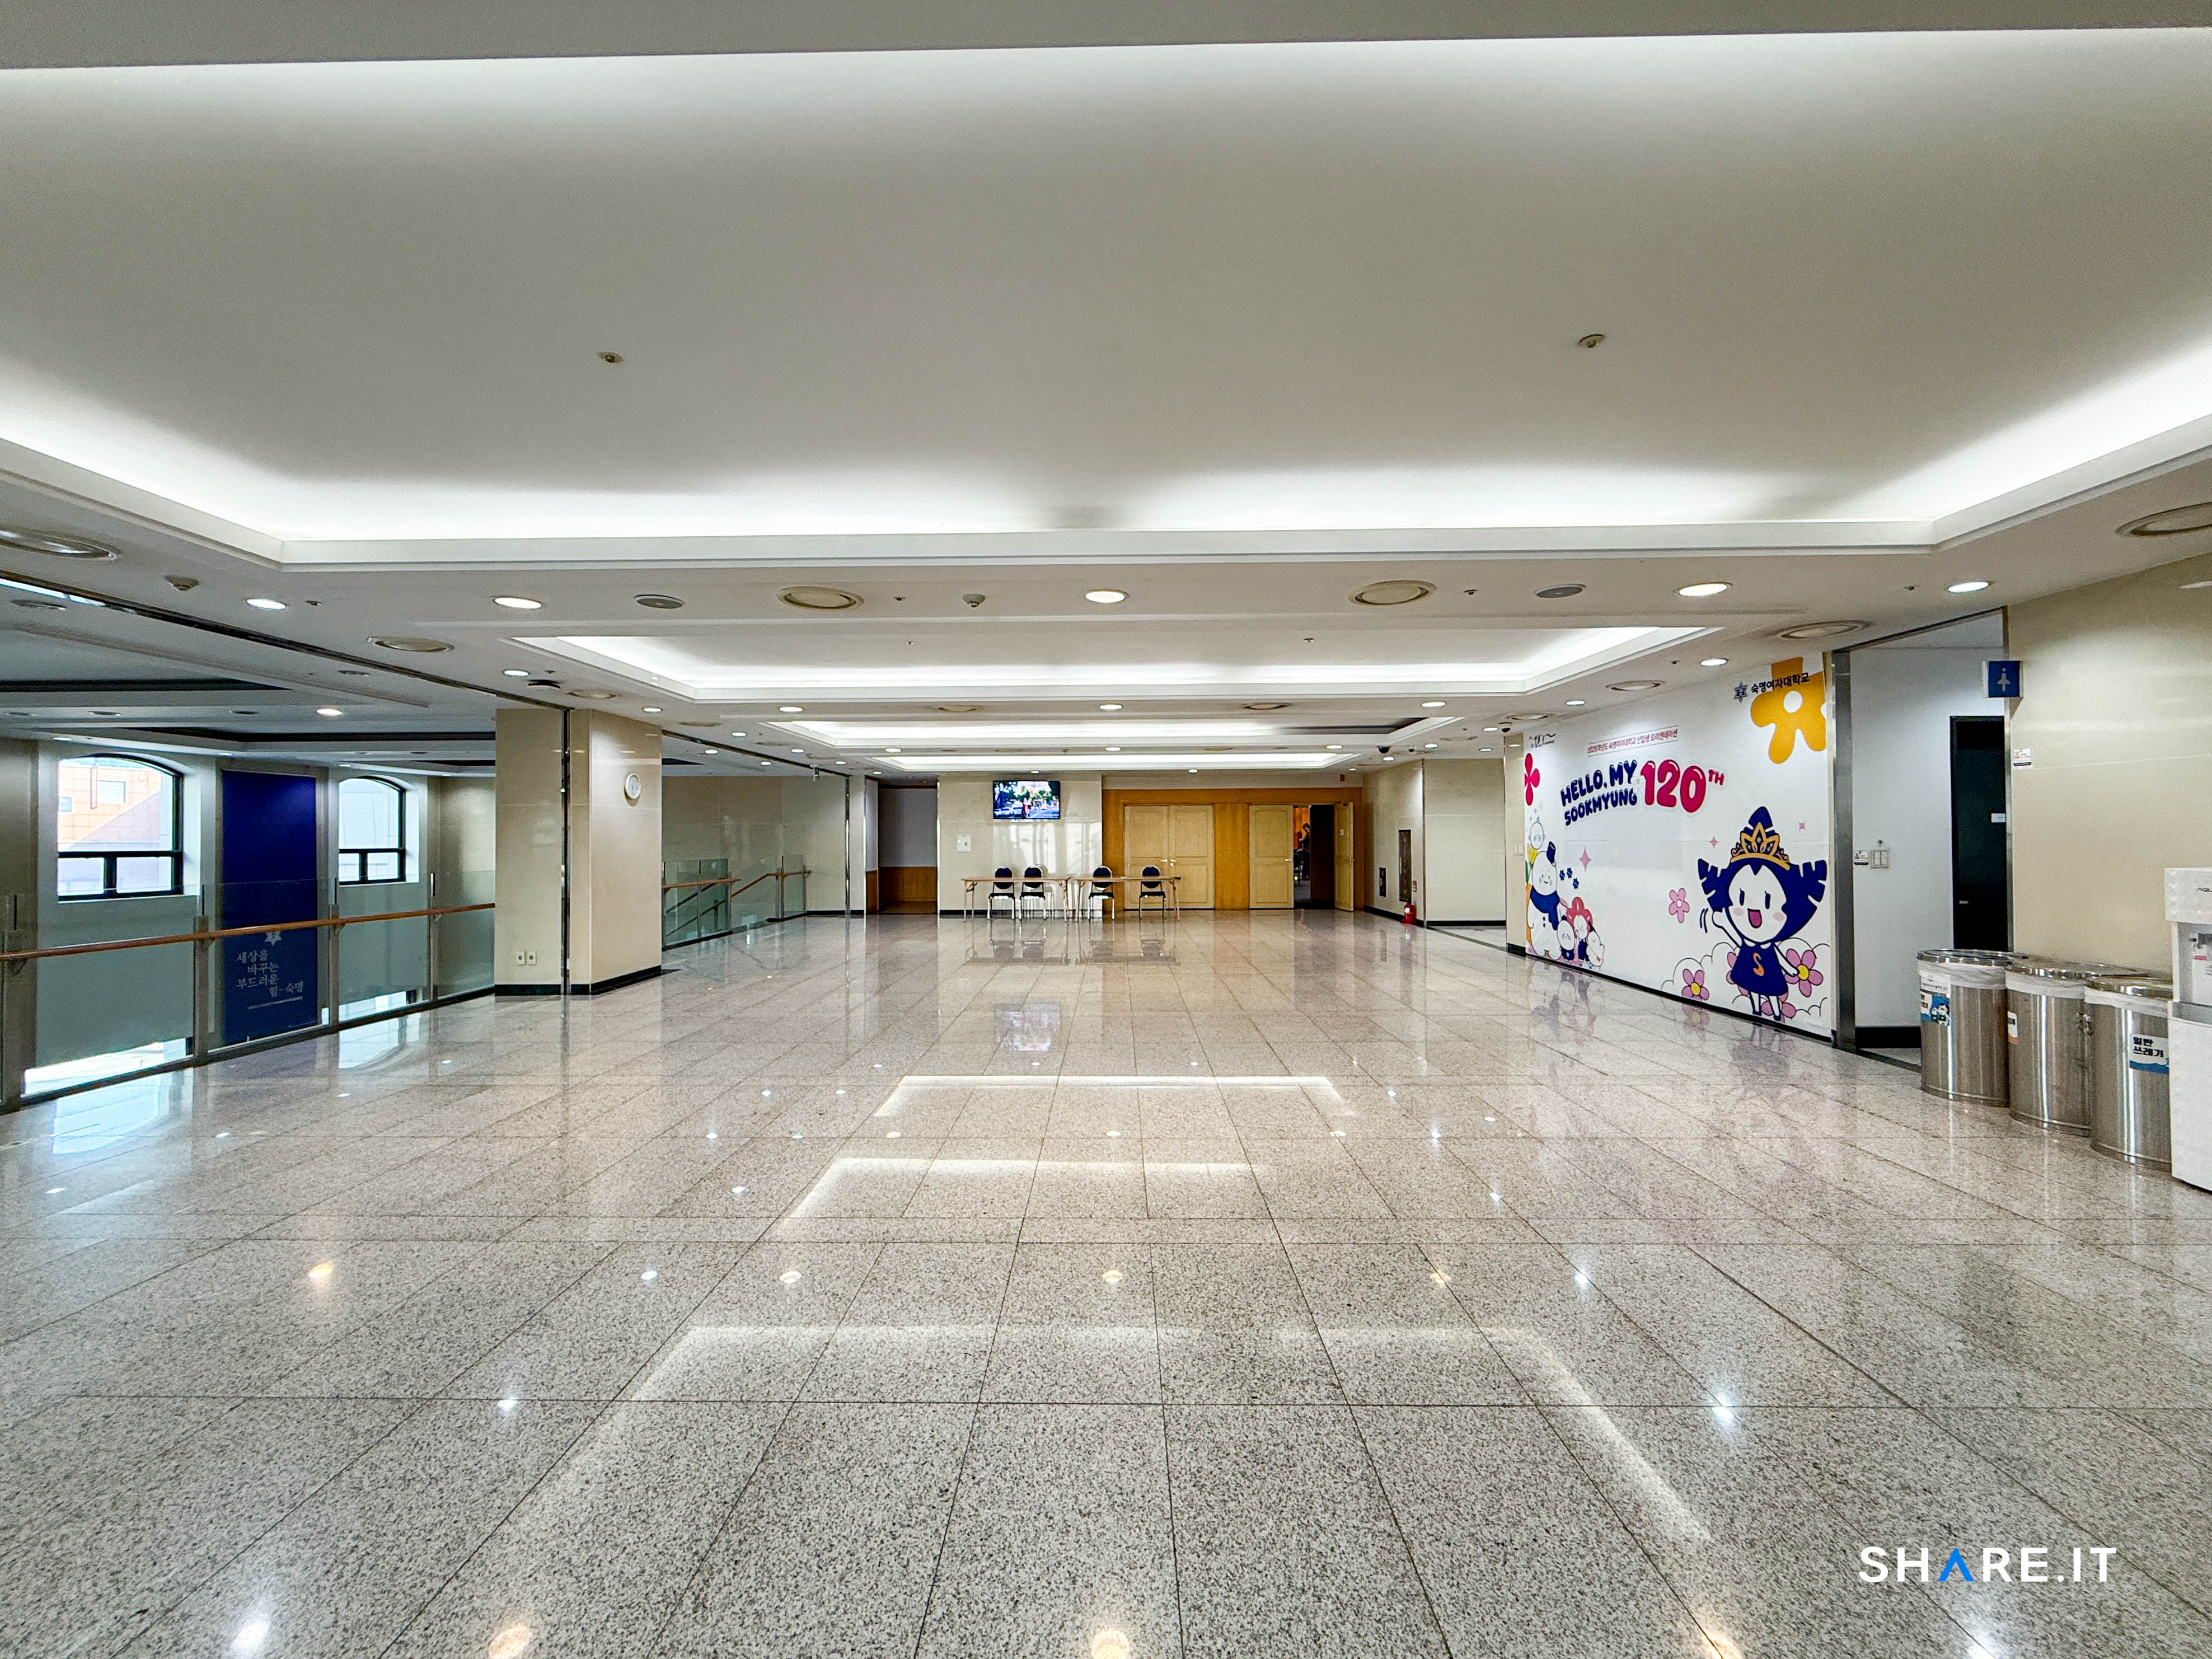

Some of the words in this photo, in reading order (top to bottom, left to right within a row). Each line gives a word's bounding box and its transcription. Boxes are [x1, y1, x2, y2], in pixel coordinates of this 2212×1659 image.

[1751, 672, 1810, 693] 숙명여자대학교
[1609, 737, 1636, 749] 숙명여자대학교
[1637, 734, 1649, 744] 신입생
[1650, 729, 1678, 741] 오리엔테이션
[1560, 770, 1608, 807] HELLO,
[1609, 760, 1637, 785] MY
[1564, 788, 1638, 826] SOOKMYUNG
[236, 949, 269, 963] 세상을
[247, 962, 279, 975] 바꾸는
[237, 974, 279, 990] 부드러운
[2133, 1037, 2154, 1047] 일반
[2132, 1046, 2164, 1058] 쓰레기
